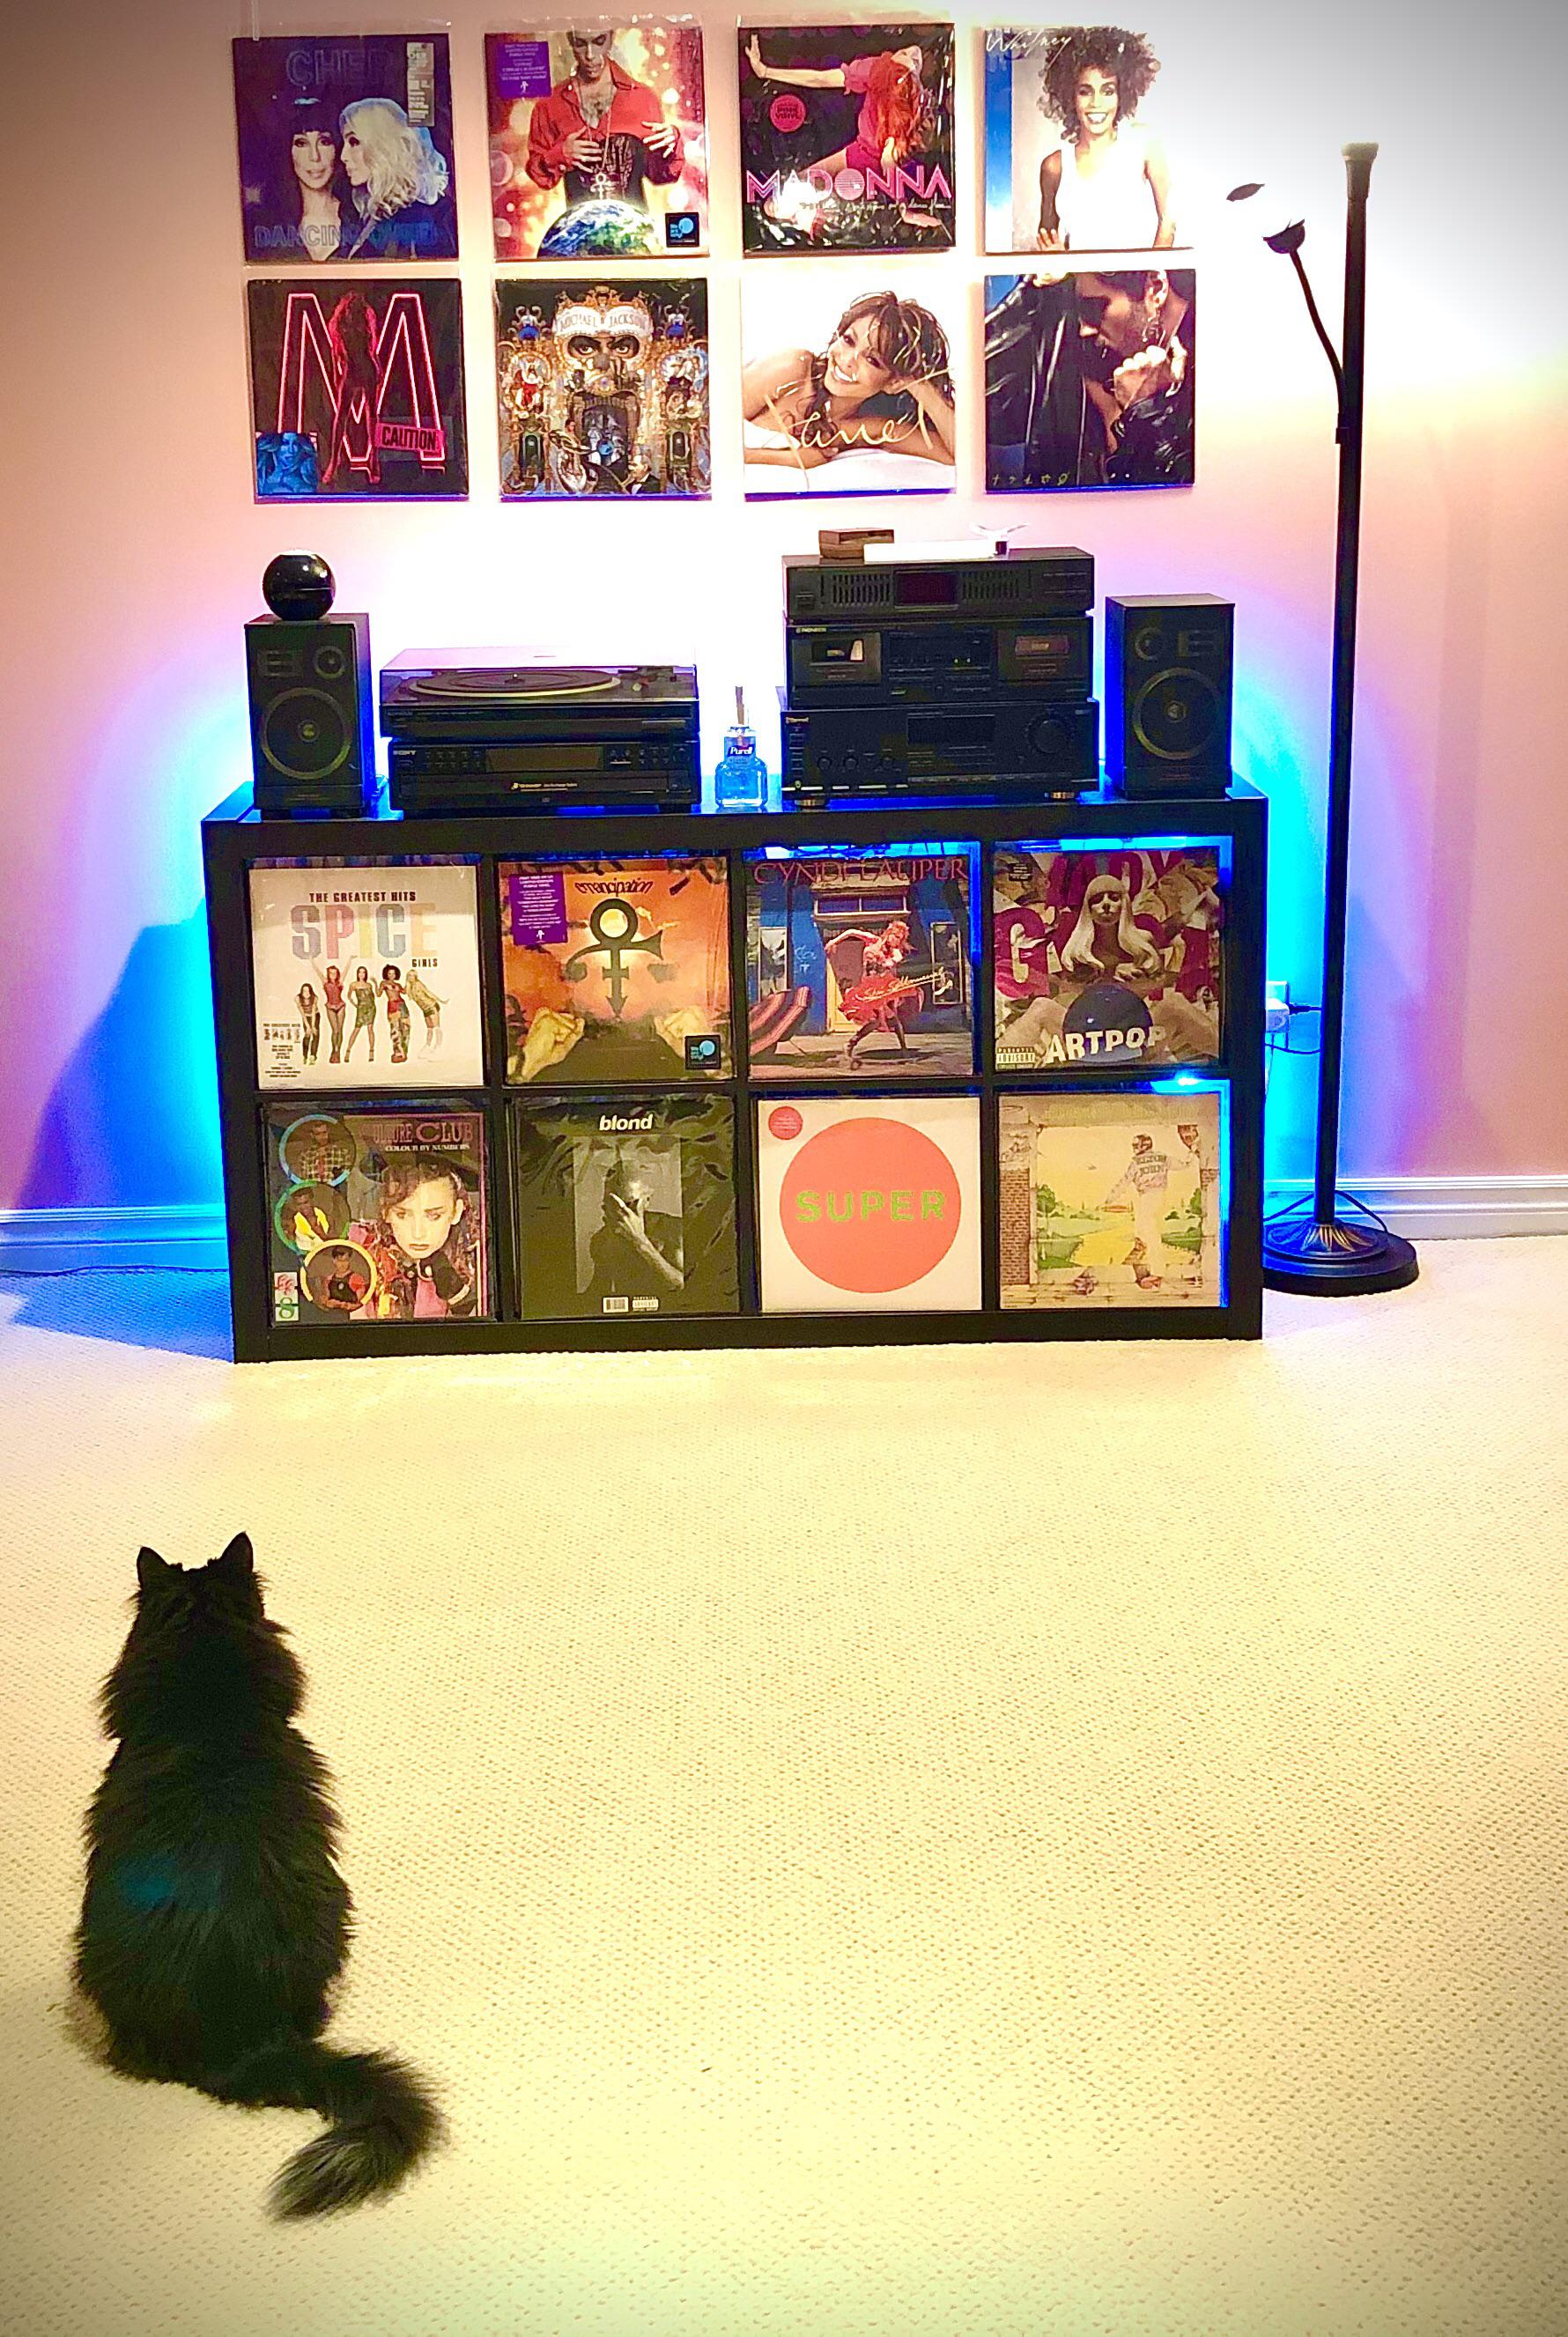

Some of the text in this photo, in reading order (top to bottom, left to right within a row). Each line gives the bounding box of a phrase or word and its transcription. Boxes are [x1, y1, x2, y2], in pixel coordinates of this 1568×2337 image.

[254, 224, 362, 248] DANCIN
[381, 425, 437, 451] CAUTION
[754, 857, 969, 888] CYNDI LAUPER
[309, 891, 417, 903] THE GREATEST HITS
[574, 876, 654, 897] emancipation
[290, 902, 439, 960] SPICE
[411, 958, 439, 968] GIRLS
[1044, 1025, 1166, 1064] ARTPOP
[416, 1122, 474, 1143] CLUB
[599, 1113, 654, 1131] blond
[795, 1189, 946, 1224] SUPER
